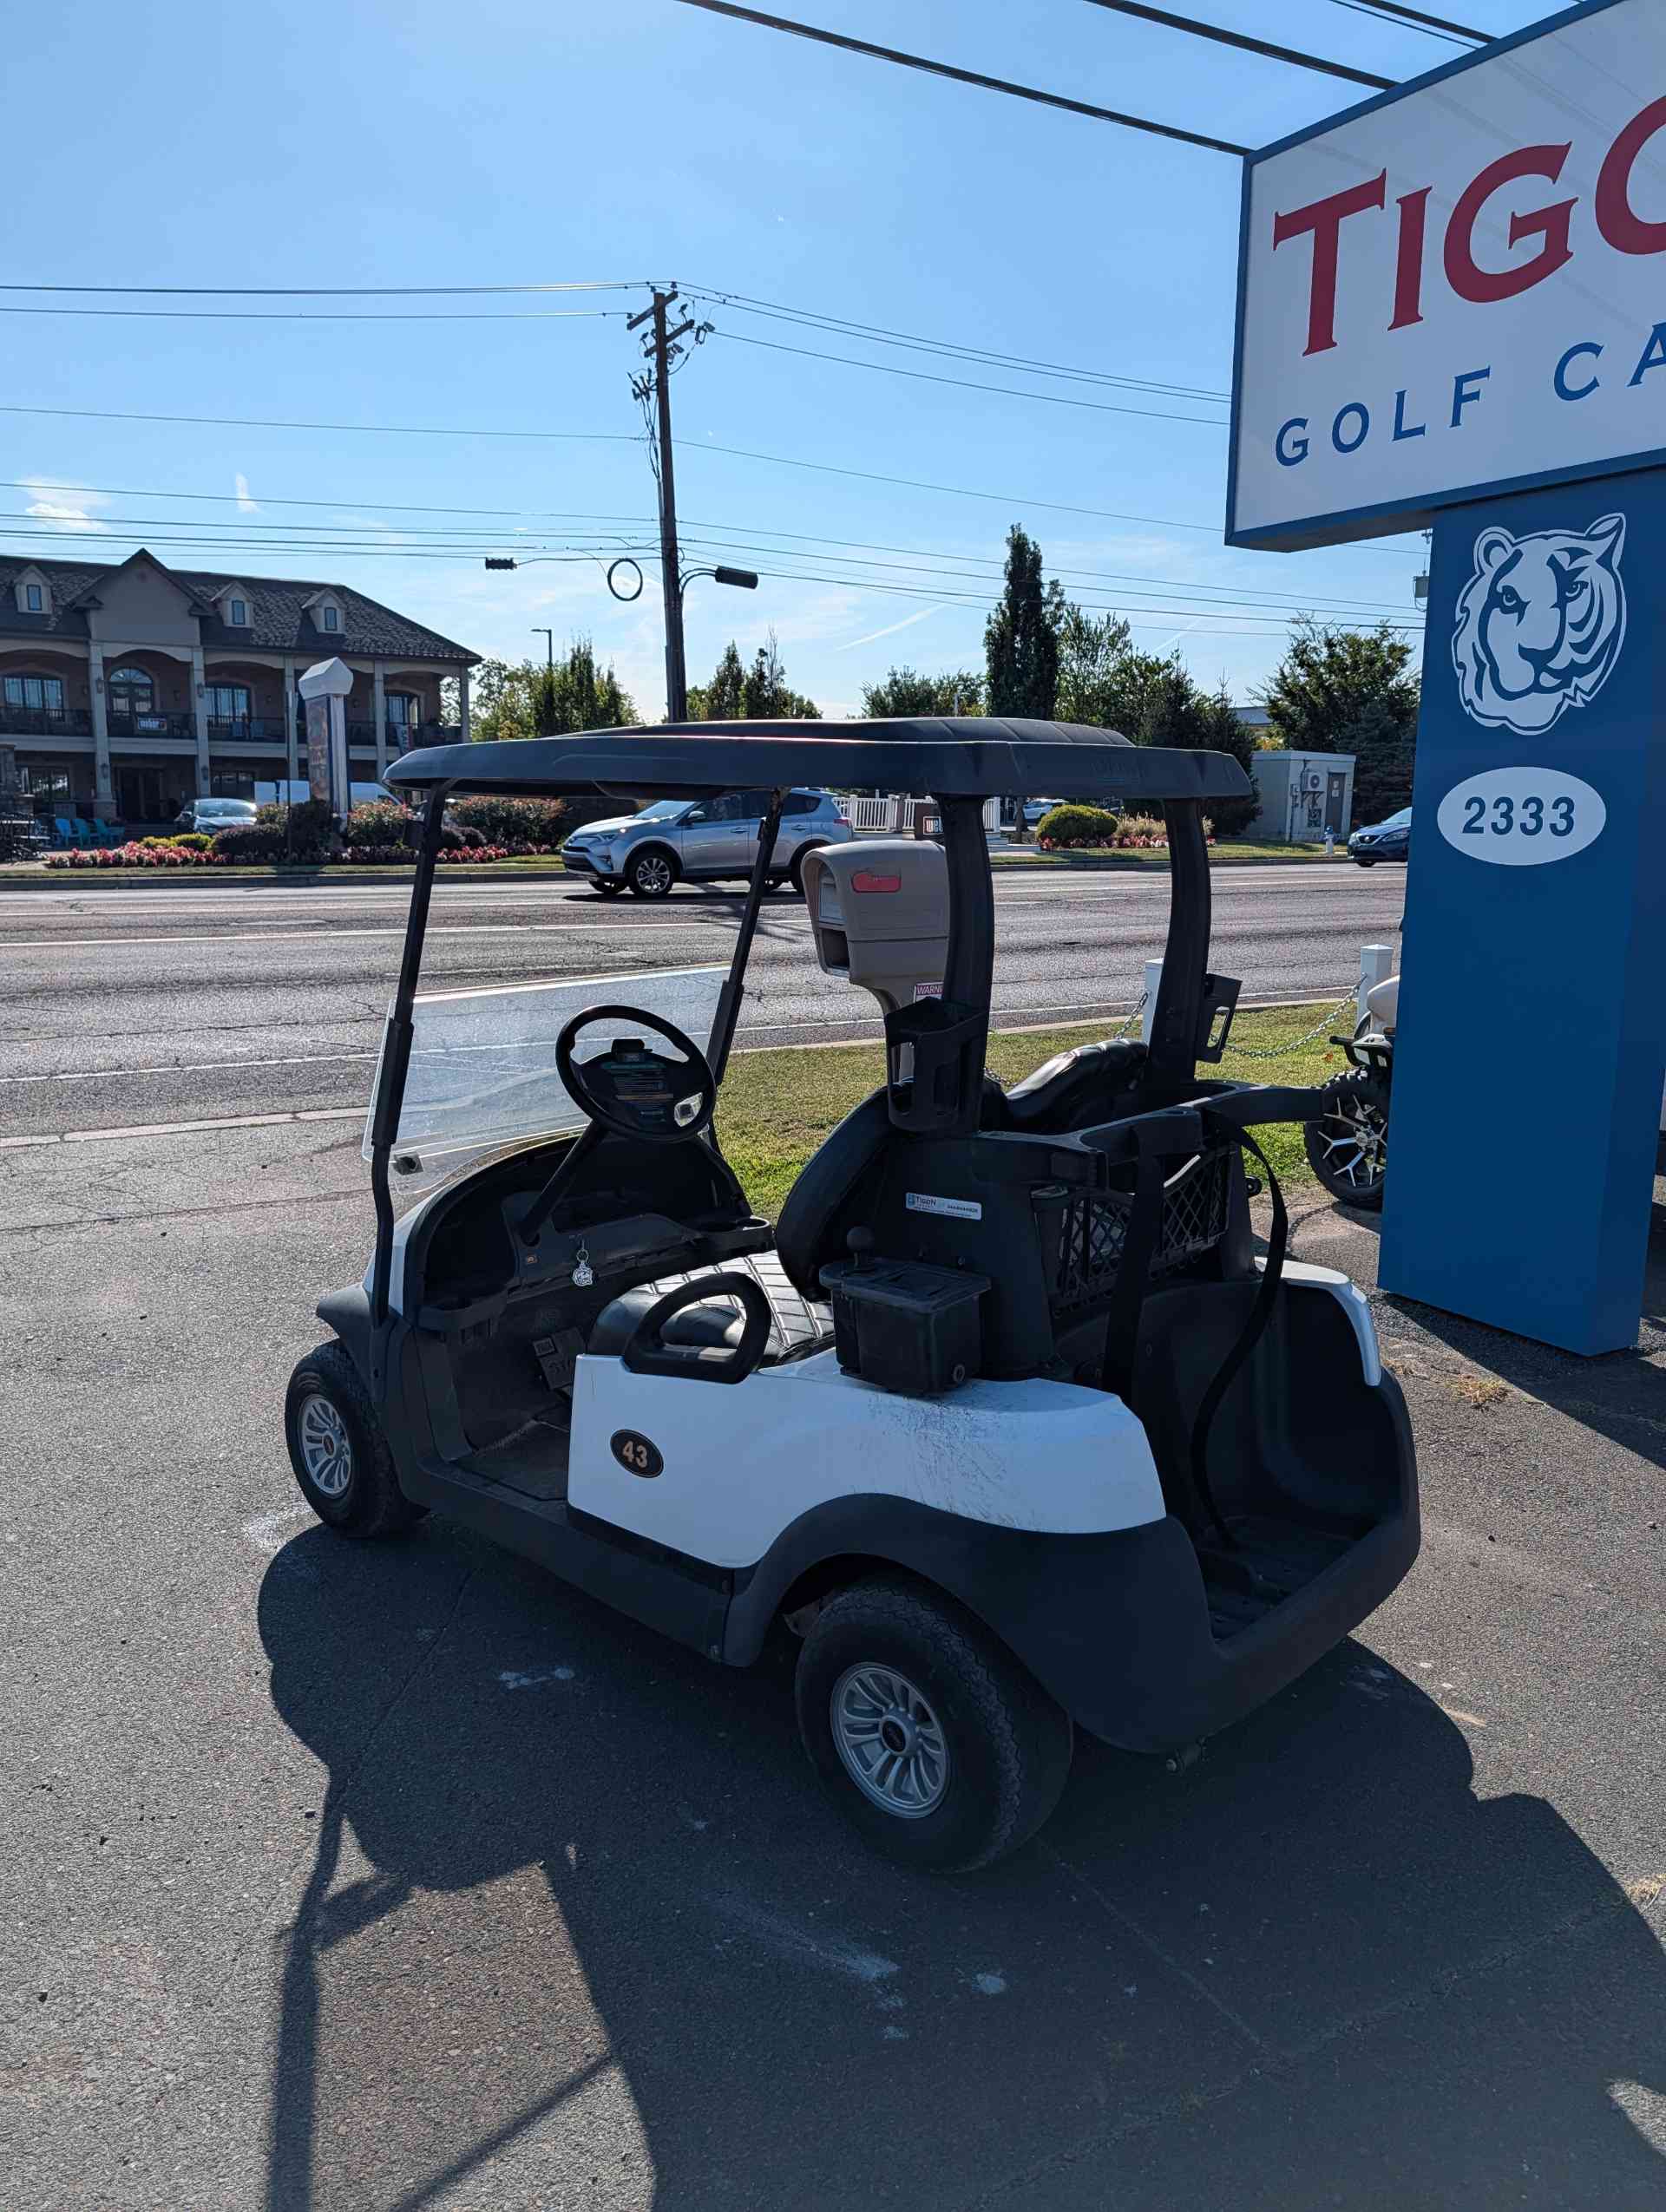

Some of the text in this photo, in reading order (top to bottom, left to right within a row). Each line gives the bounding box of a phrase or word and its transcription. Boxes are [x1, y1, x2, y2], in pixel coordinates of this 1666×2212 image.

[1274, 321, 1666, 468] GOLF CA
[1461, 795, 1576, 837] 2333
[915, 1196, 937, 1207] TIGON
[622, 1440, 648, 1469] 43
